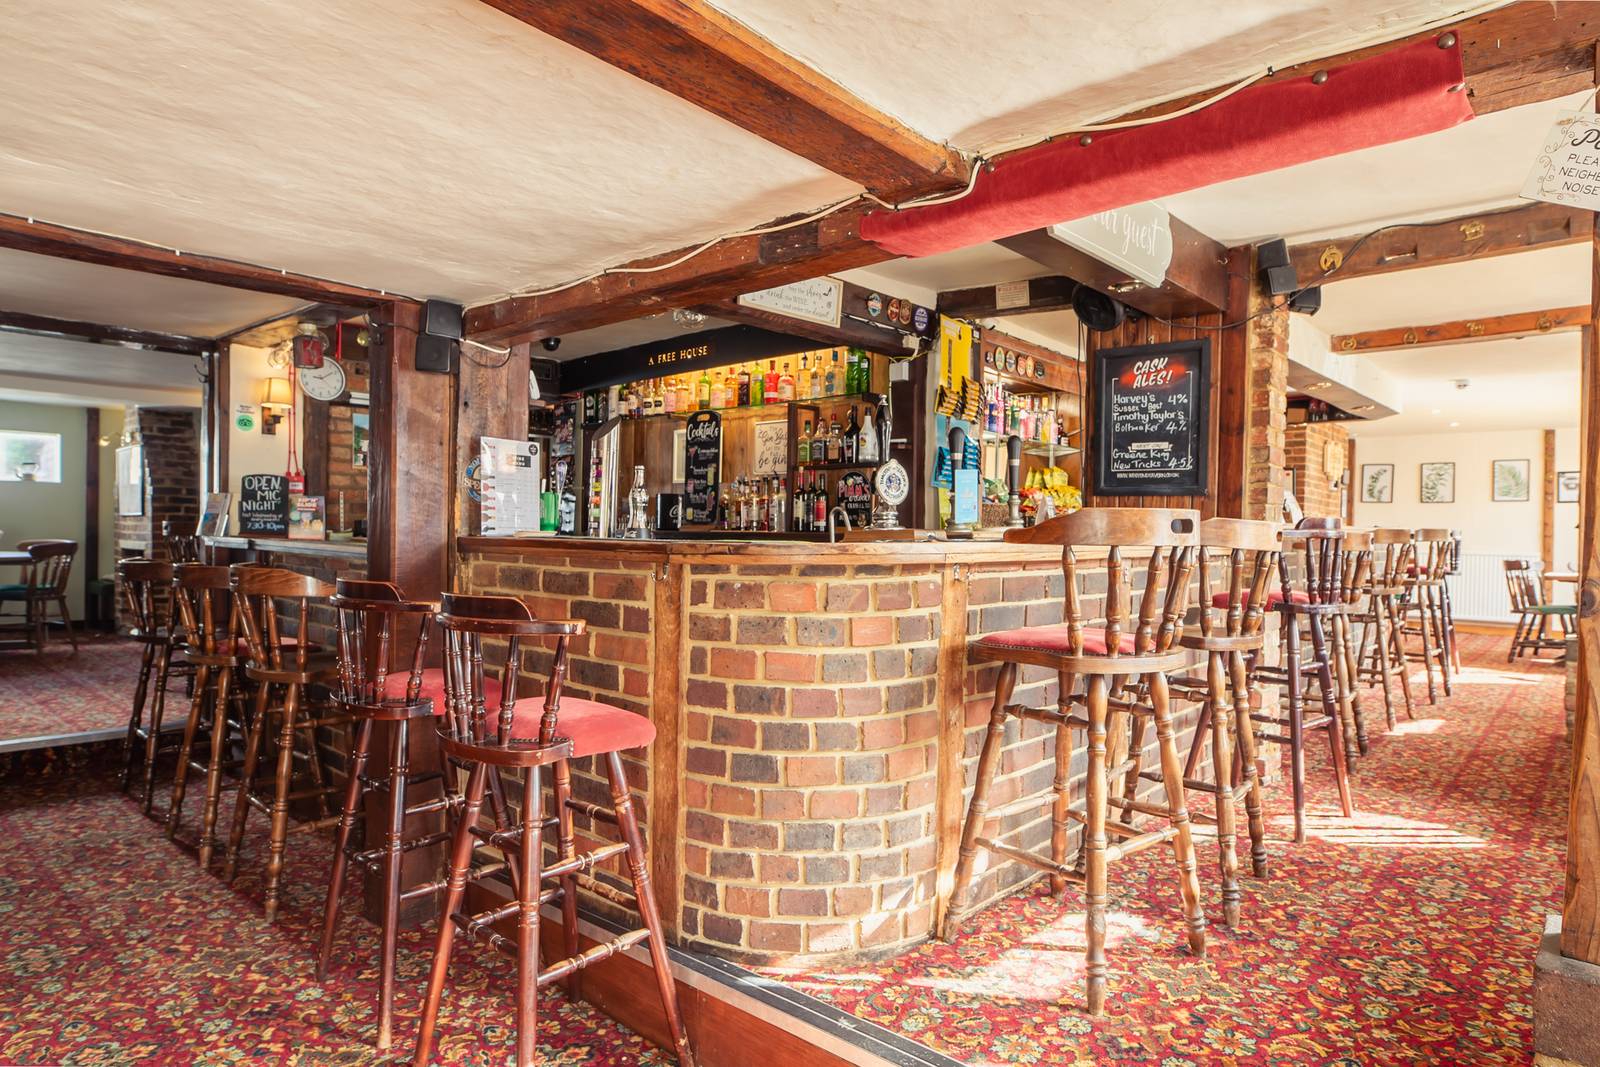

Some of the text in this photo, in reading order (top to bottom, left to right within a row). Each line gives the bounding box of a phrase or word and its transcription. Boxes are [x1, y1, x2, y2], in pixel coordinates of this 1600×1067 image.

[1562, 181, 1600, 196] NOISE
[1121, 214, 1166, 256] guest
[648, 345, 708, 366] A FREE HOUSE
[1133, 357, 1169, 375] CASK
[1133, 370, 1173, 389] ALES!
[1113, 392, 1188, 408] Harvey's 4%
[1113, 401, 1163, 413] Sussex Best
[1112, 409, 1185, 424] Timothy Taylor's
[687, 421, 719, 440] Cocktails
[1114, 419, 1187, 434] Boltmaker 4%
[1112, 448, 1170, 461] Greene King
[1113, 459, 1131, 470] New
[1131, 459, 1161, 469] Tricks
[244, 476, 281, 491] OPEN
[256, 490, 281, 501] MIC
[242, 500, 277, 511] NIGHT
